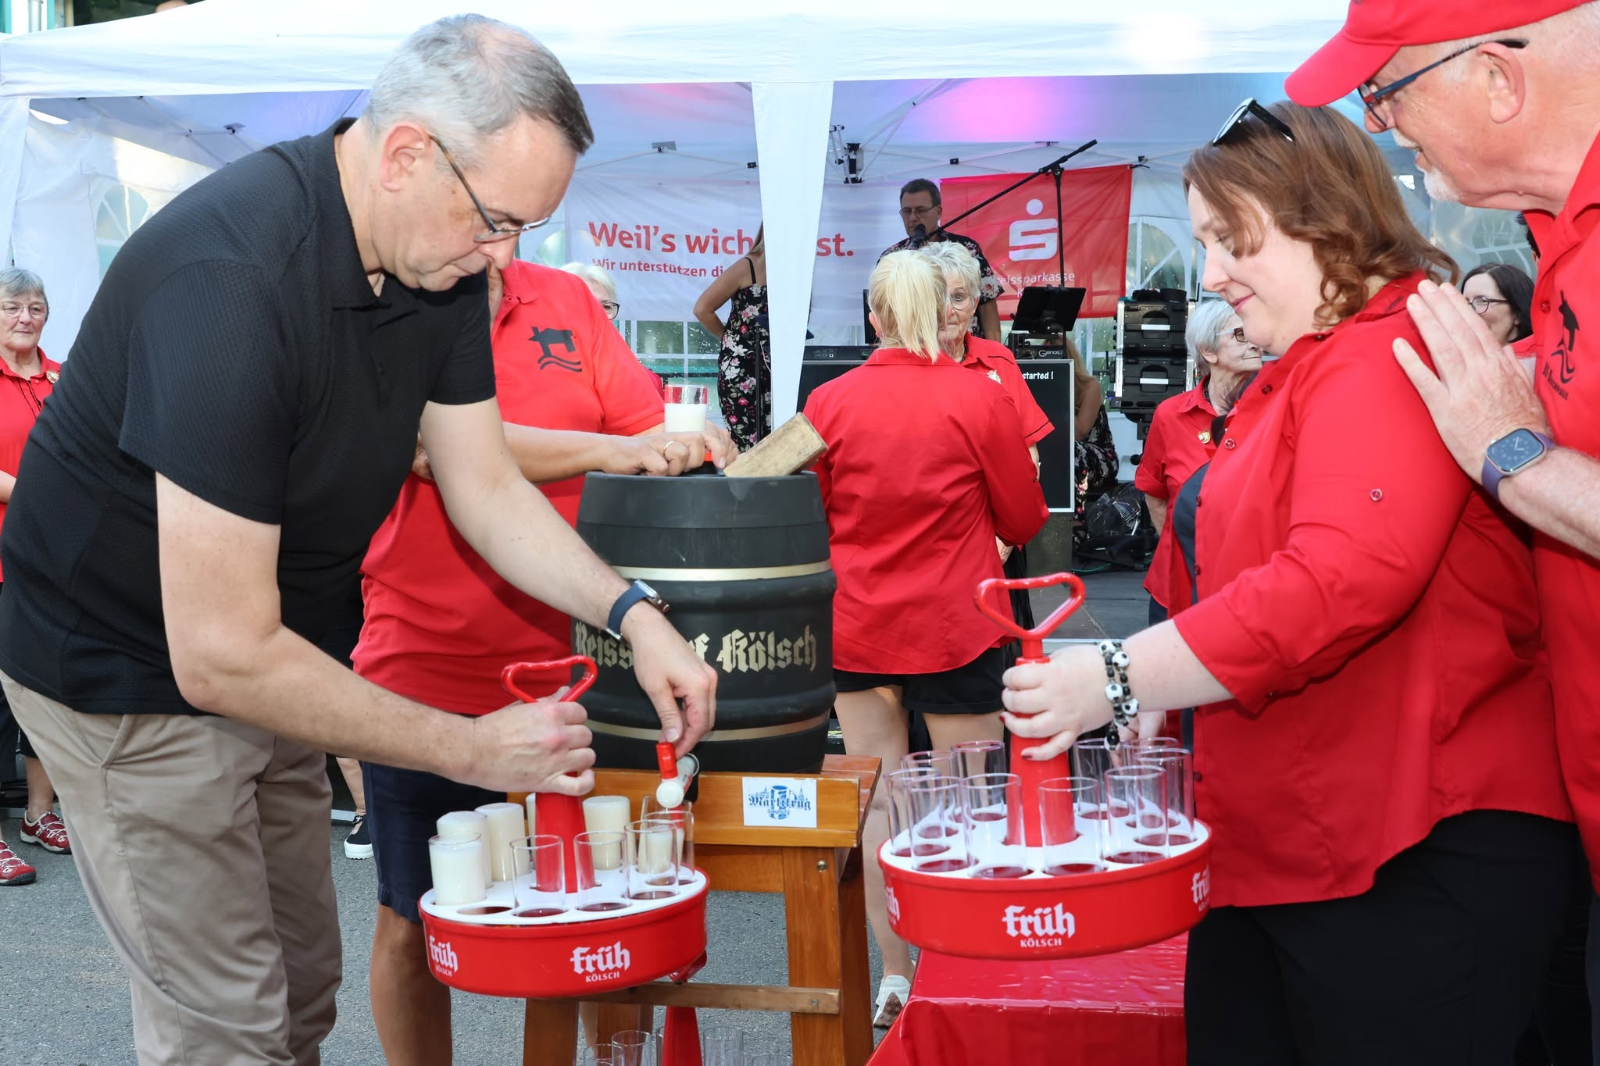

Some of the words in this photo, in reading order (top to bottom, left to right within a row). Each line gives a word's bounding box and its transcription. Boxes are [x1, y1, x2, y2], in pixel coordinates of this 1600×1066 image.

[589, 222, 675, 253] Weil's
[685, 228, 754, 255] wich
[592, 258, 616, 271] Wir
[619, 260, 707, 278] unterstützen
[716, 624, 817, 674] Kölsch
[1020, 937, 1062, 948] KÖLSCH
[585, 971, 620, 983] KÖLSCH
